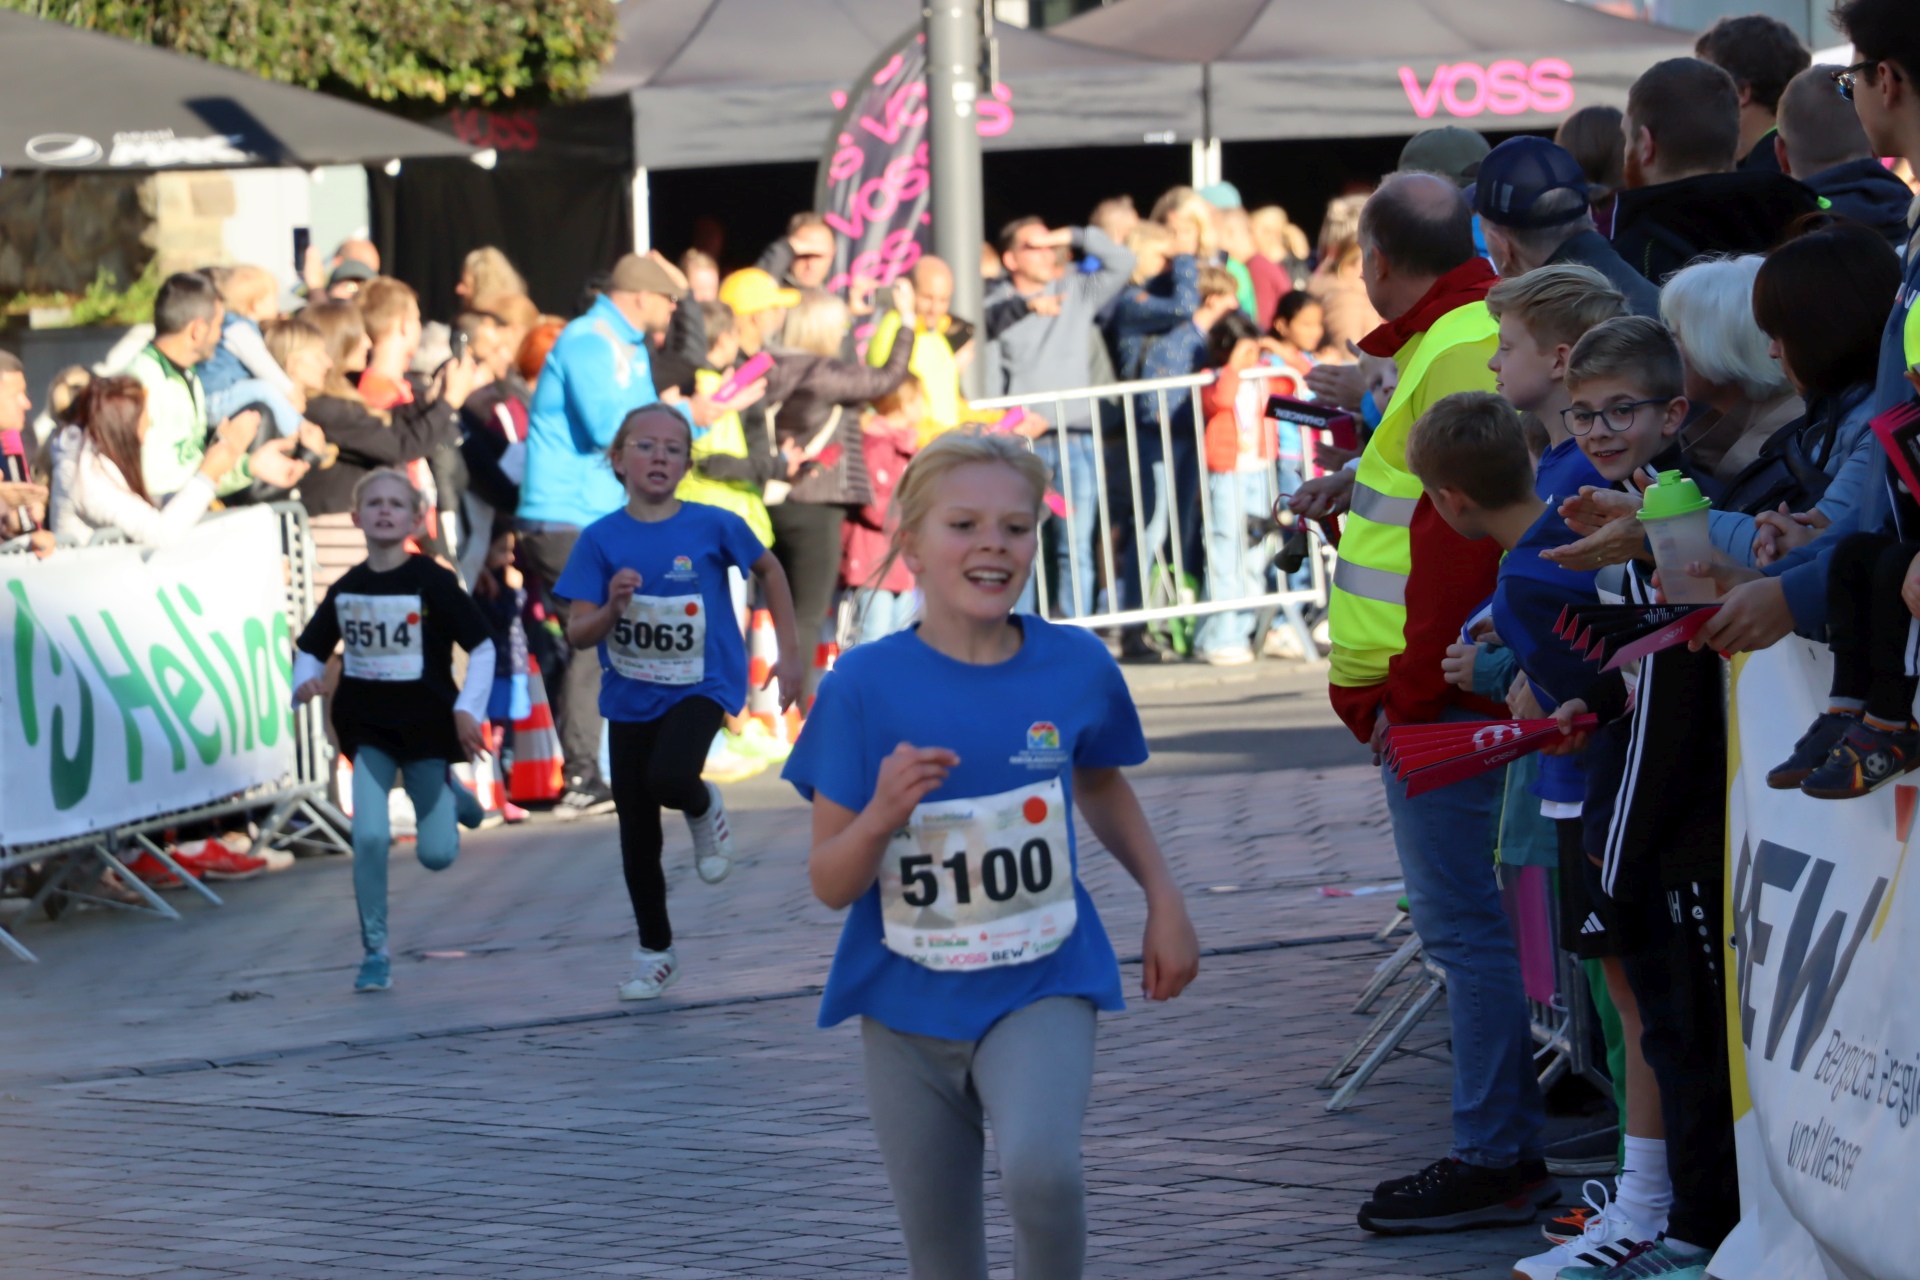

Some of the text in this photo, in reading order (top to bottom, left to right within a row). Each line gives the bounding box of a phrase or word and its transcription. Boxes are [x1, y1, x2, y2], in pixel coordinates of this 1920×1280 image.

[1398, 57, 1575, 118] VOSS
[345, 620, 411, 648] 5514
[615, 617, 694, 652] 5063
[67, 582, 296, 784] Helios
[1484, 748, 1519, 766] VOSS
[900, 837, 1053, 908] 5100
[945, 952, 989, 967] VOSS
[992, 946, 1024, 962] BEW
[1733, 830, 1889, 1073] BEW
